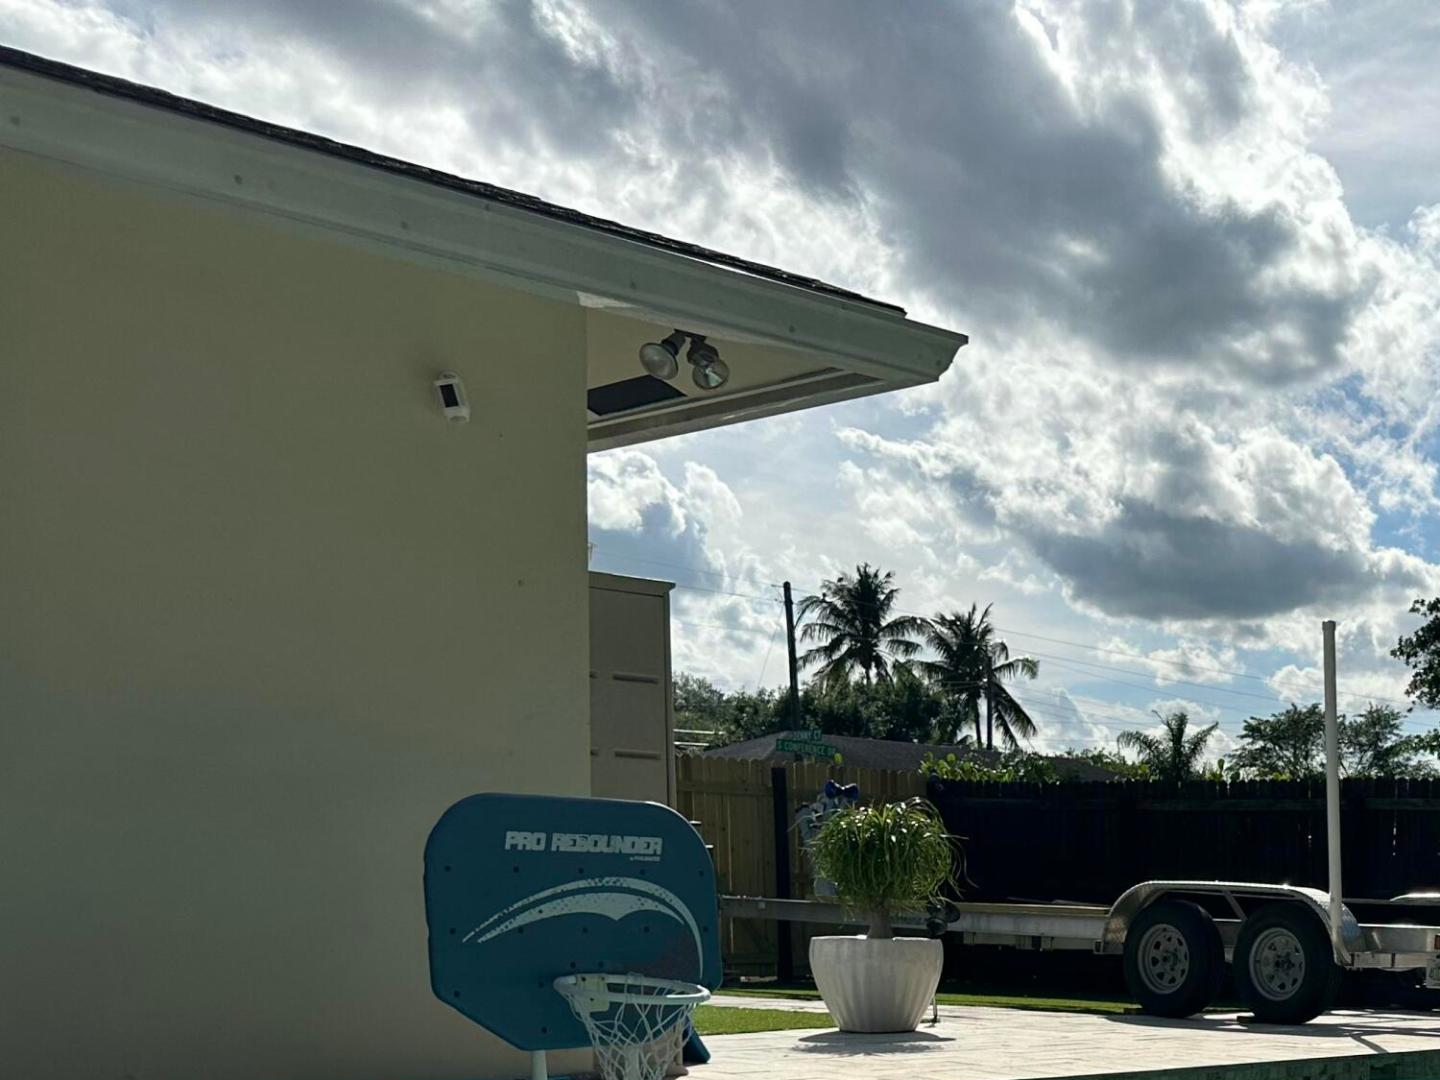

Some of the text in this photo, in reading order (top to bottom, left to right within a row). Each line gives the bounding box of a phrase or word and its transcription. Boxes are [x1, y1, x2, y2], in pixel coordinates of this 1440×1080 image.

[784, 741, 825, 756] CONFERENCE
[505, 831, 662, 854] PRO REBOUNDER
